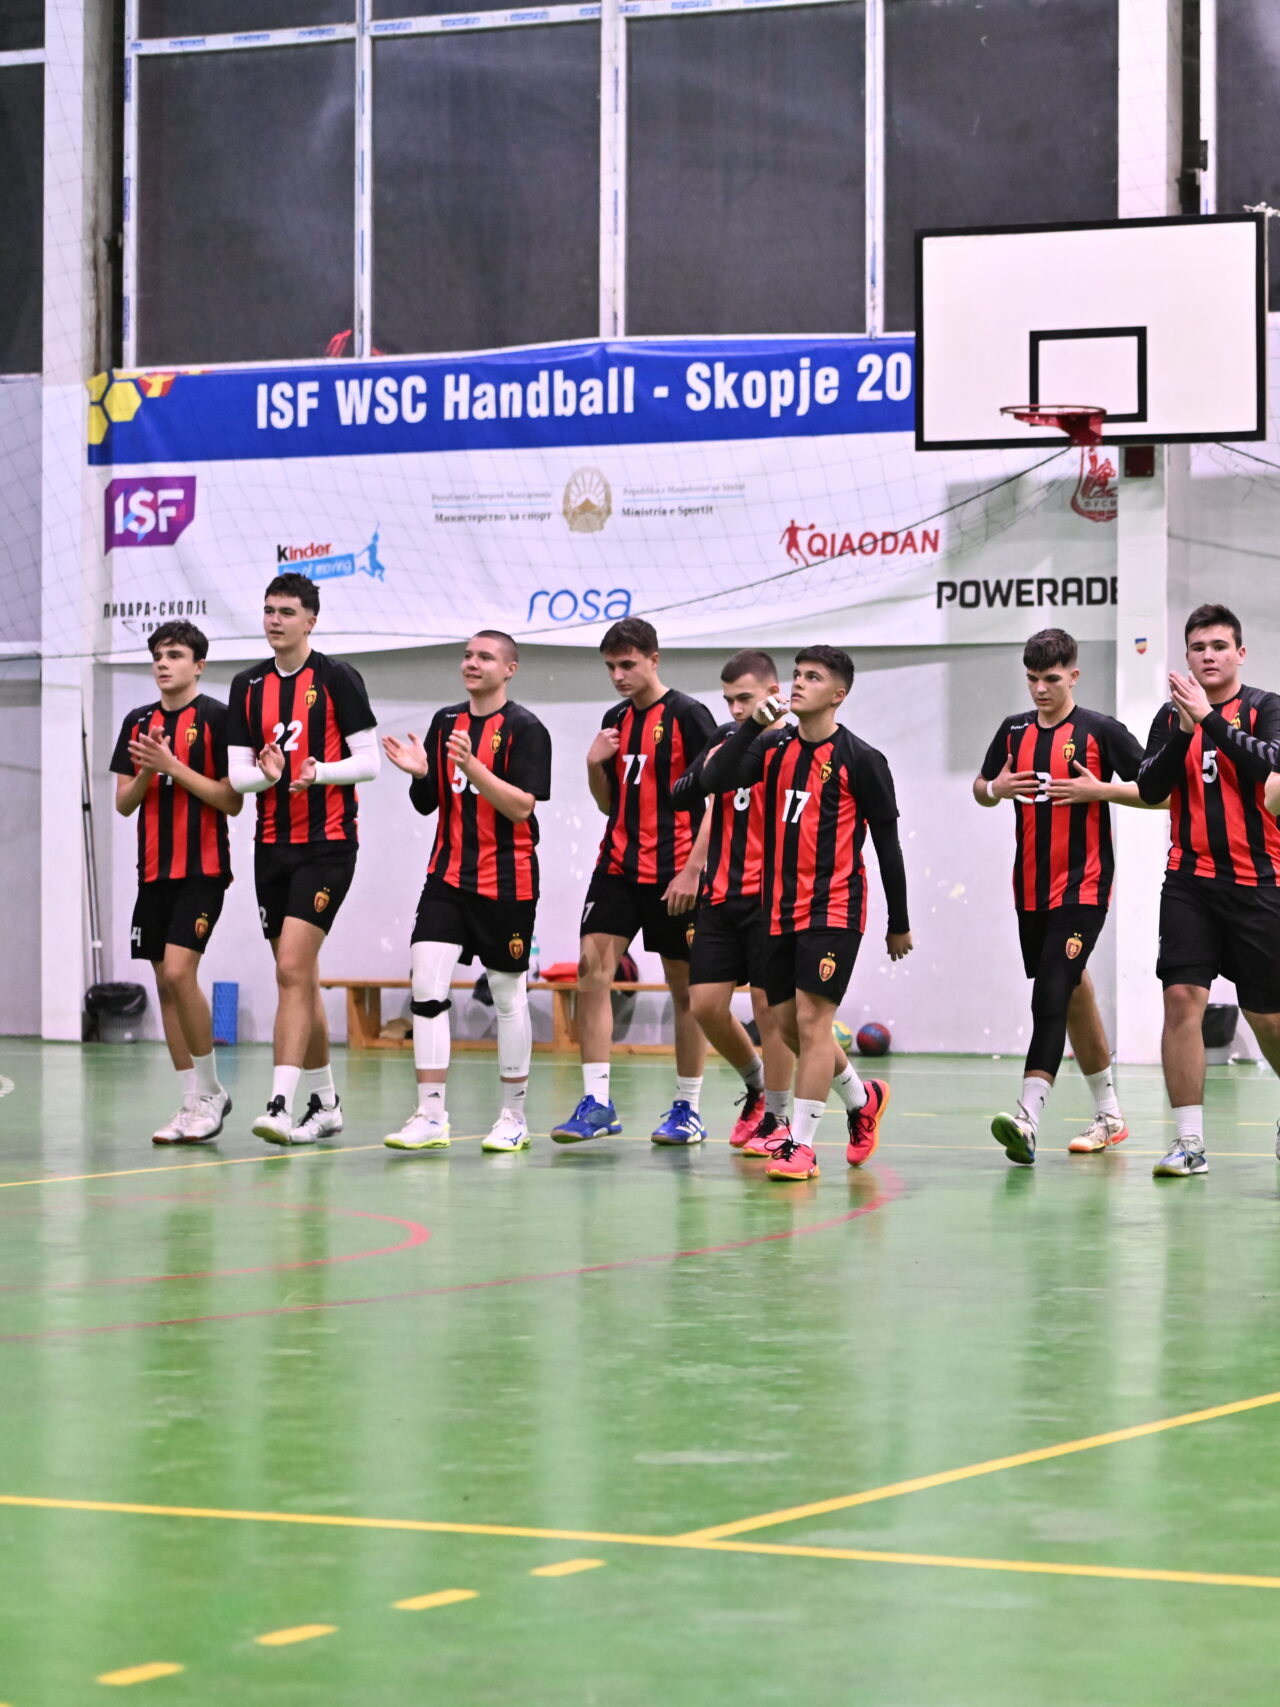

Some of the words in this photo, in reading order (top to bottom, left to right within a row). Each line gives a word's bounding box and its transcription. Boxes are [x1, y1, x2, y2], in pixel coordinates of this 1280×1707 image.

[257, 381, 319, 429] ISF
[335, 375, 427, 425] WSC
[444, 366, 635, 420] Handball
[685, 356, 839, 418] Skopje
[856, 352, 912, 401] 20
[114, 488, 185, 535] ISF
[622, 507, 667, 517] Ministria
[276, 541, 333, 563] kinder
[807, 528, 940, 558] QIAODAN
[526, 587, 632, 622] rosa
[622, 754, 648, 785] 77
[1201, 749, 1218, 783] 5
[1034, 771, 1053, 802] 3
[781, 789, 812, 824] 17
